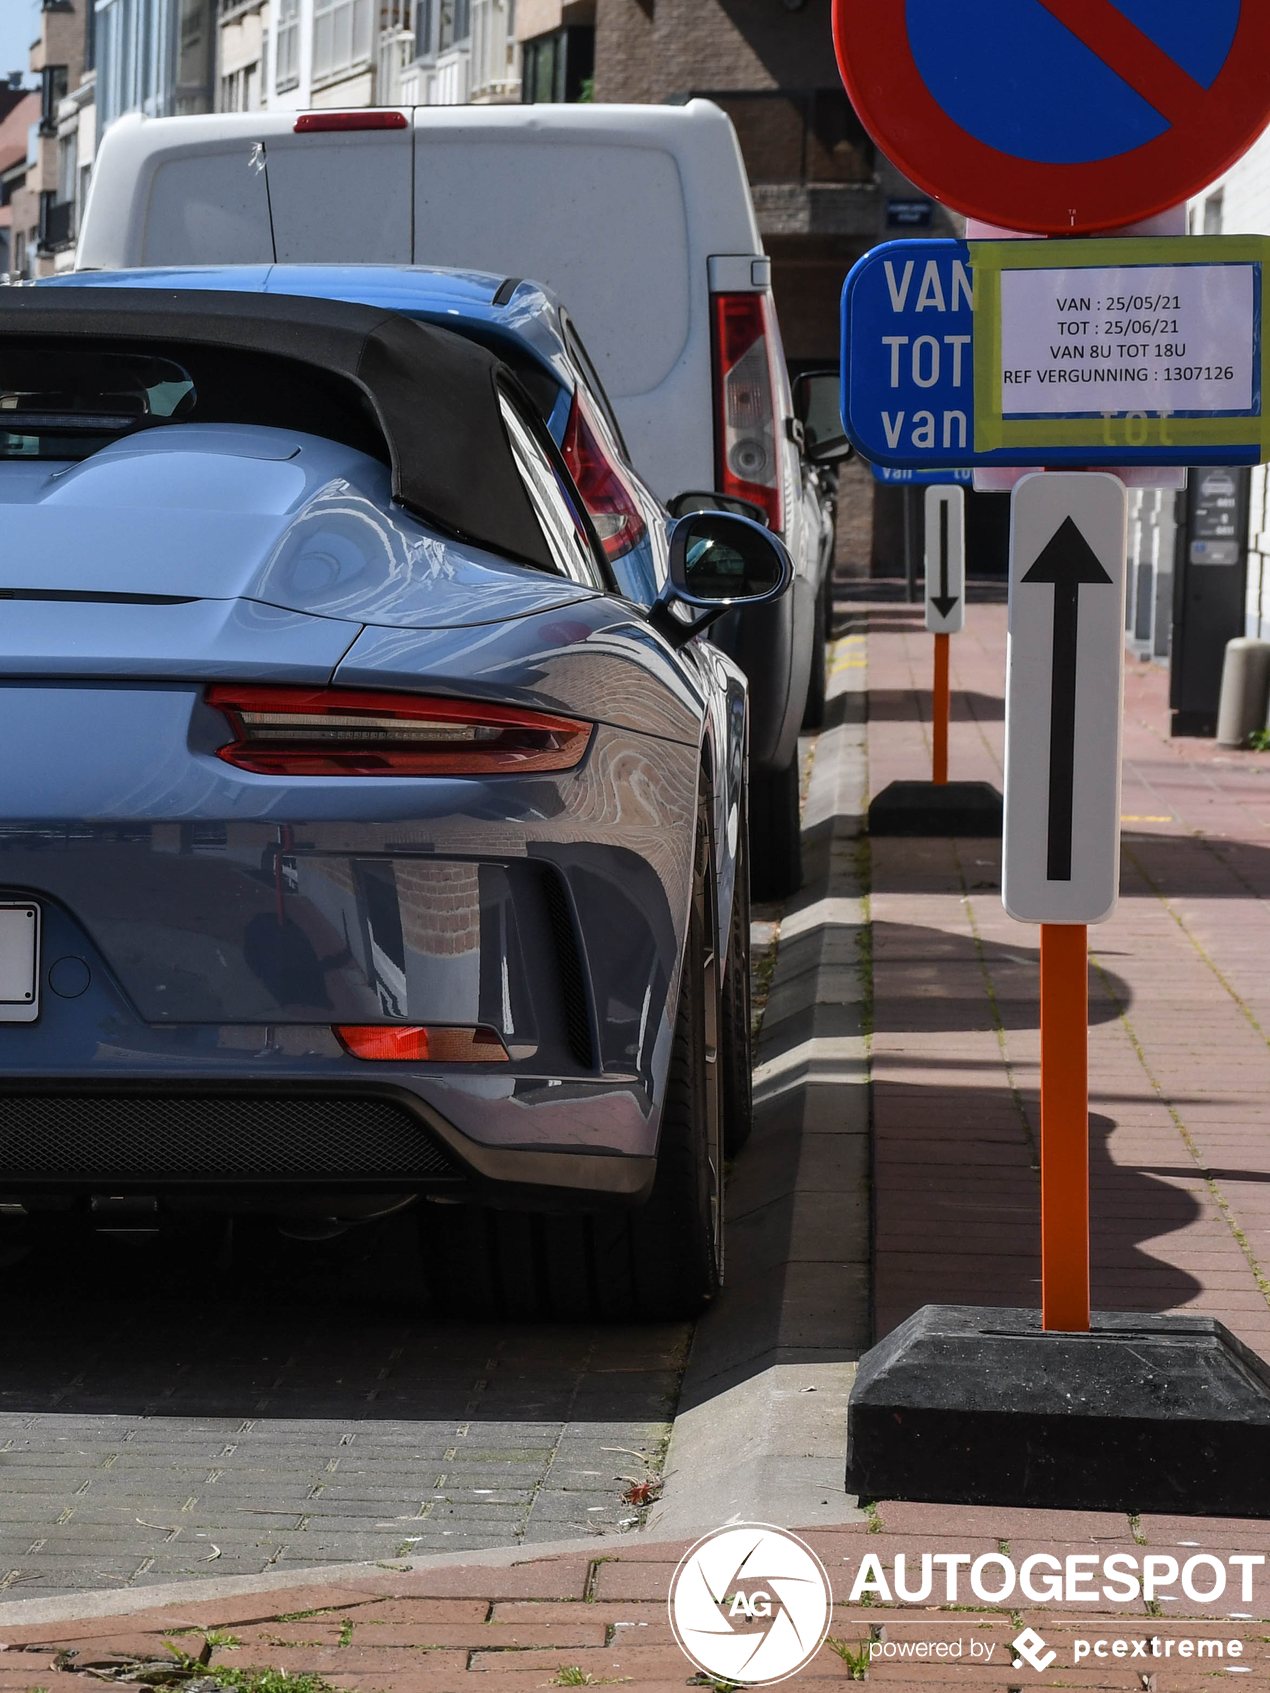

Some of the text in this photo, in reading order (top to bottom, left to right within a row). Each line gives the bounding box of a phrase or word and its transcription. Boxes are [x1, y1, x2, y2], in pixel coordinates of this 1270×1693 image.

[883, 259, 974, 313] VAN
[1055, 298, 1091, 312] VAN
[1105, 295, 1182, 312] 25/05/21
[1057, 321, 1090, 336] TOT
[1104, 318, 1180, 337] 25/06/21
[1049, 343, 1187, 359] VAN 8U TOT 18U
[881, 334, 971, 388] TOT
[1003, 370, 1032, 384] REF
[1036, 367, 1149, 383] VERGUNNING
[1163, 366, 1235, 382] 1307126
[881, 410, 968, 449] van
